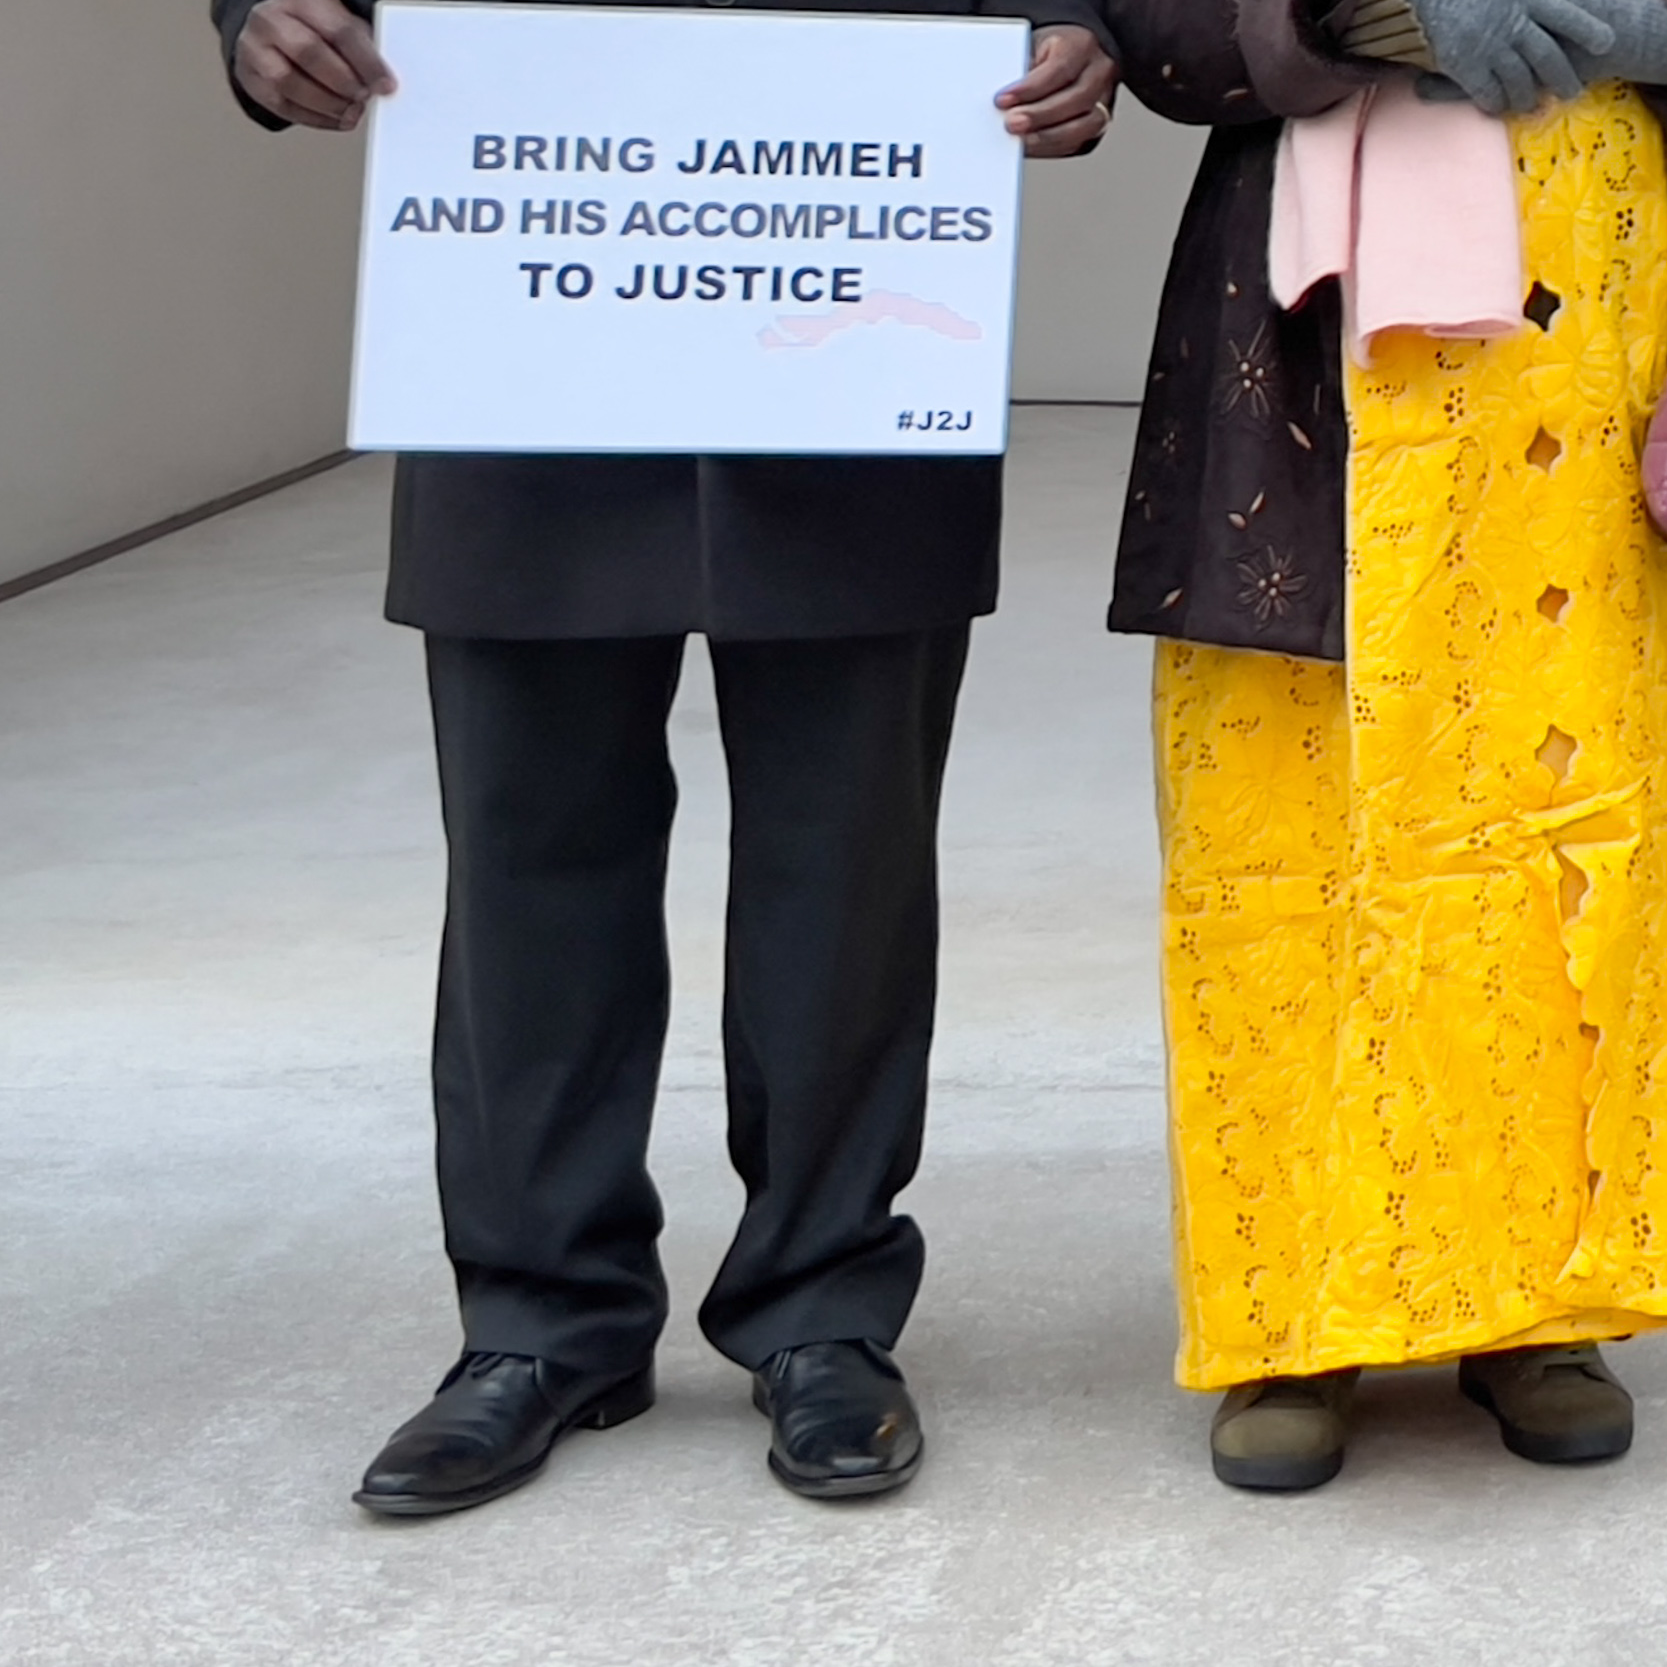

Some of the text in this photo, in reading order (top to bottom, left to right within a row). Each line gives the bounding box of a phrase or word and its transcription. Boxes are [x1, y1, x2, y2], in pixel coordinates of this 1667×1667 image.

[472, 133, 924, 179] BRING JAMMEH
[389, 196, 993, 242] AND HIS ACCOMPLICES
[518, 262, 864, 304] TO JUSTICE
[897, 410, 973, 432] #J2J
